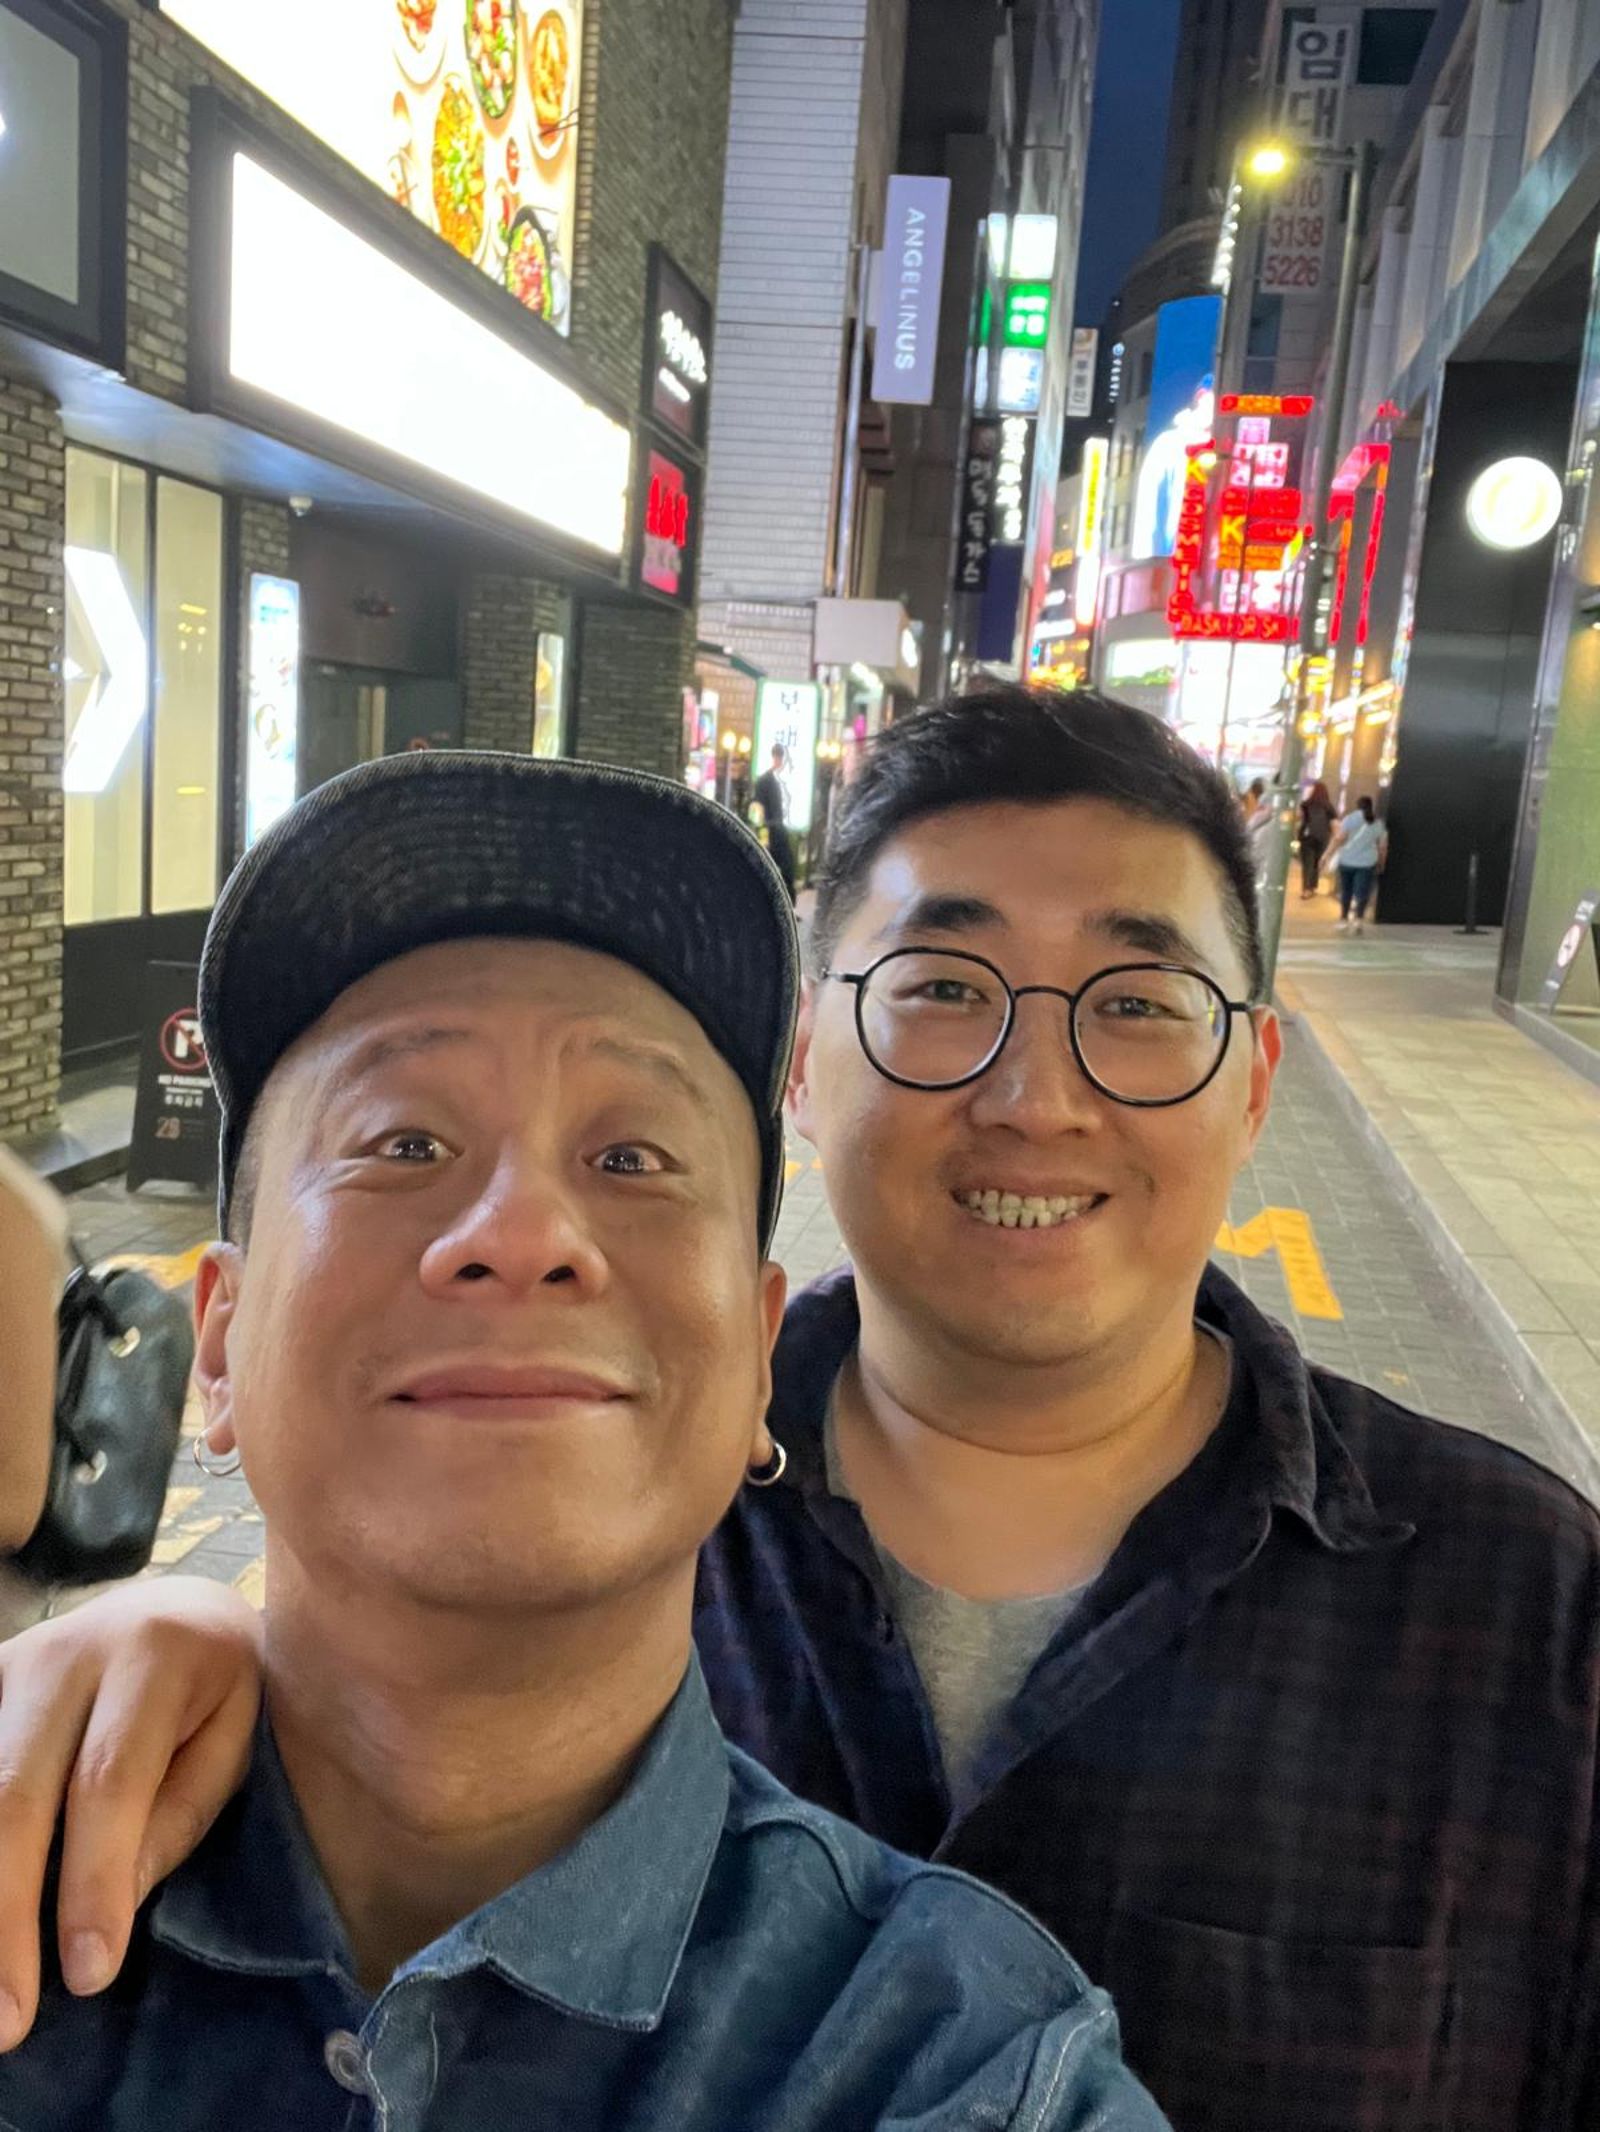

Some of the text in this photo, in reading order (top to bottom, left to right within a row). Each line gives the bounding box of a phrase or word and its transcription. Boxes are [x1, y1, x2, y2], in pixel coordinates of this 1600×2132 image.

[1269, 215, 1324, 249] 3138
[1264, 254, 1321, 287] 5226
[894, 207, 926, 370] ANGELINUS
